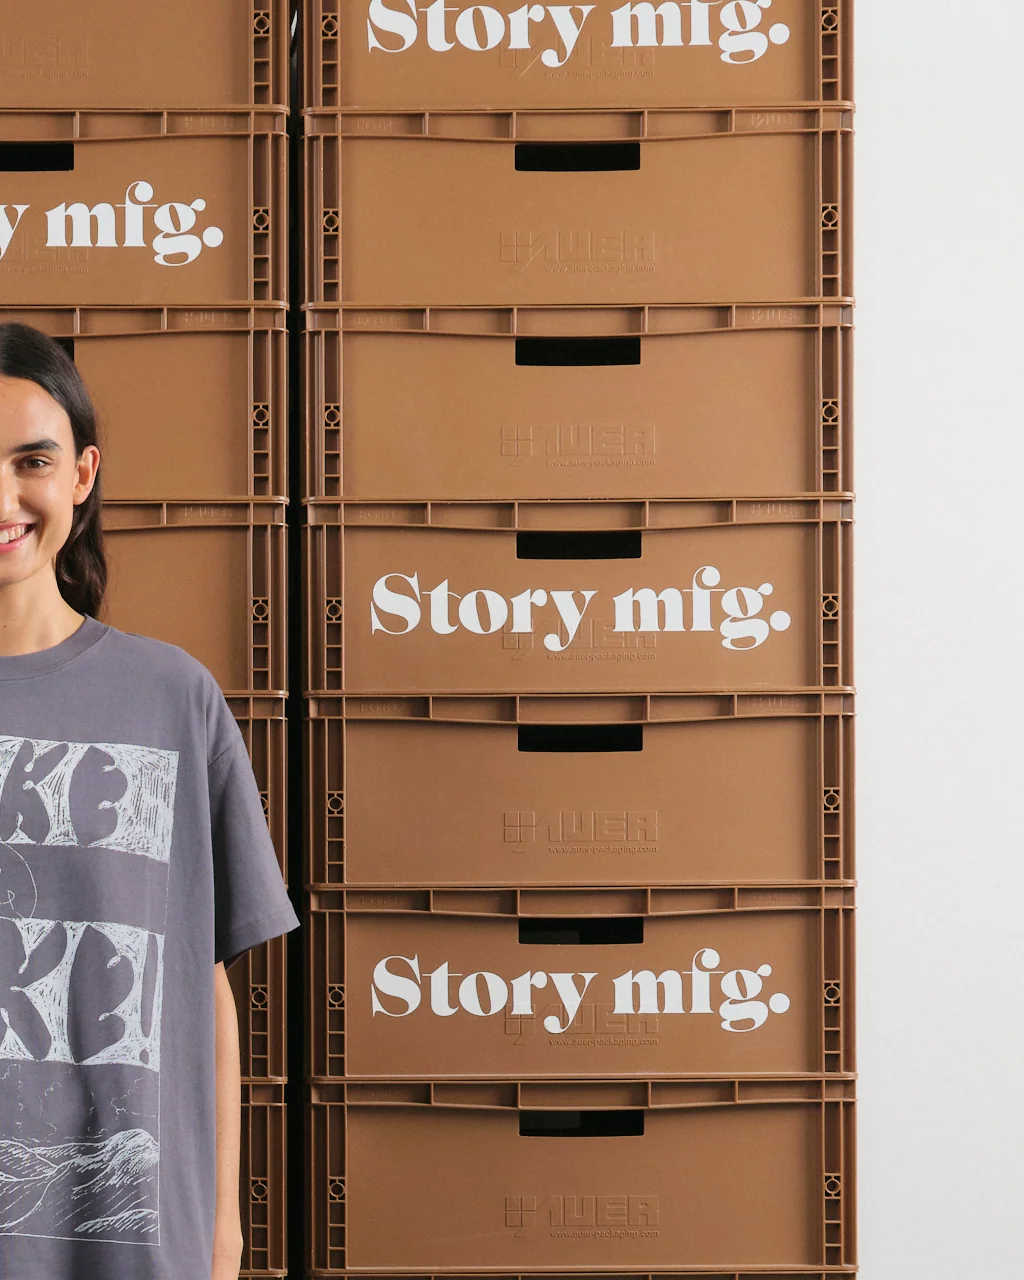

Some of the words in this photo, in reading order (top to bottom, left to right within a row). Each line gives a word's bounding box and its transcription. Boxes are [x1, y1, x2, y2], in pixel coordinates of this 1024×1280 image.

[367, 0, 597, 67] Story
[610, 0, 790, 65] mfg.
[44, 181, 224, 267] mfg.
[370, 571, 598, 652] Story
[612, 565, 792, 651] mfg.
[370, 954, 599, 1034] Story
[612, 947, 791, 1033] mfg.
